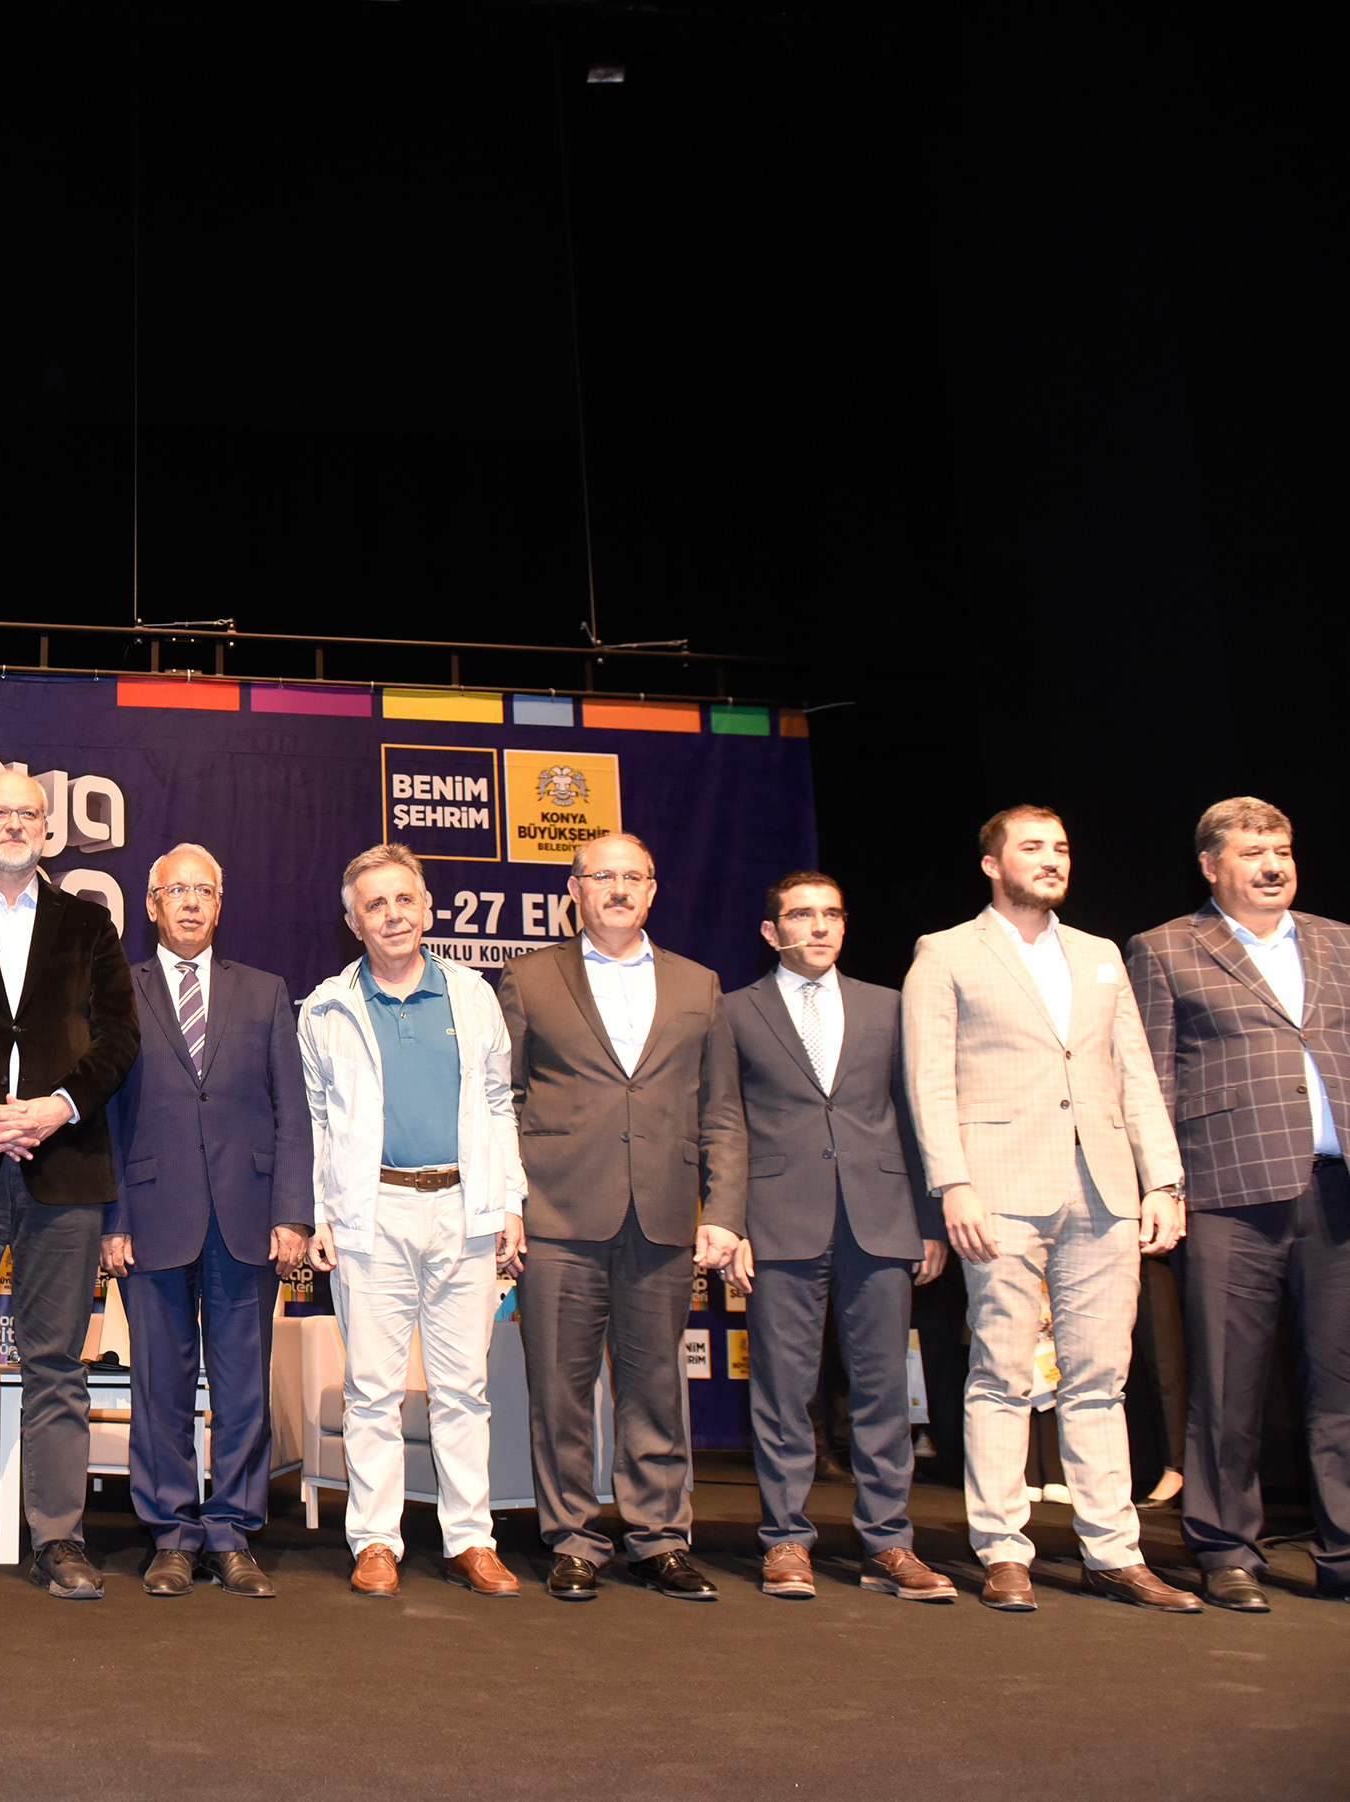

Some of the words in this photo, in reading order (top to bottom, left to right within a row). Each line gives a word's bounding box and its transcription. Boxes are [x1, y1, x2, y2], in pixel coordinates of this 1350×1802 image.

[392, 773, 489, 802] BENİM
[393, 804, 490, 830] ŞEHRİM
[541, 811, 588, 825] KONYA
